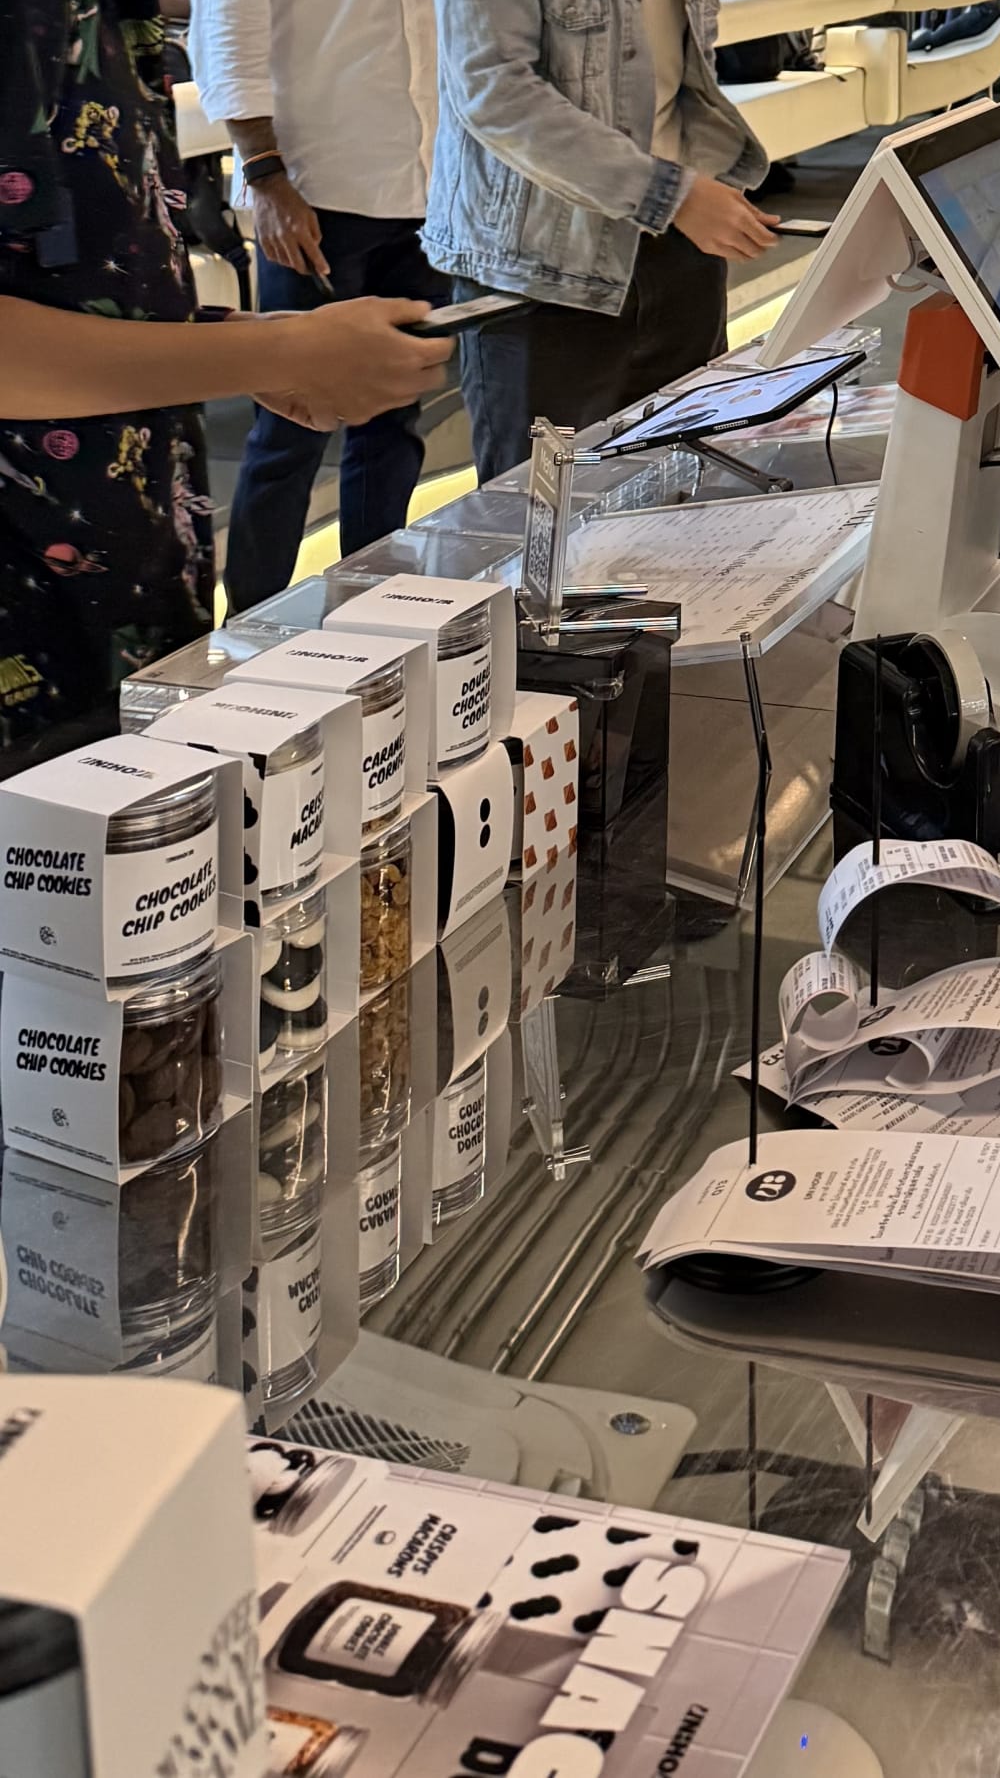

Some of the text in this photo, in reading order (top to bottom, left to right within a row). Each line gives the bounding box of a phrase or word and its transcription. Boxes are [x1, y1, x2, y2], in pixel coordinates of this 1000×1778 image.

[757, 566, 817, 607] Signature
[6, 847, 85, 872] CHOCOLATE
[4, 871, 92, 897] CHIP COOKIES
[135, 856, 213, 913] CHOCOLATE
[122, 874, 217, 937] CHIP COOKIES
[18, 1028, 101, 1057] CHOCOLATE
[16, 1052, 107, 1082] CHIP COOKIES
[711, 1179, 729, 1197] Q13
[386, 1512, 443, 1579] MACARONS
[411, 1523, 458, 1577] CRISPYS
